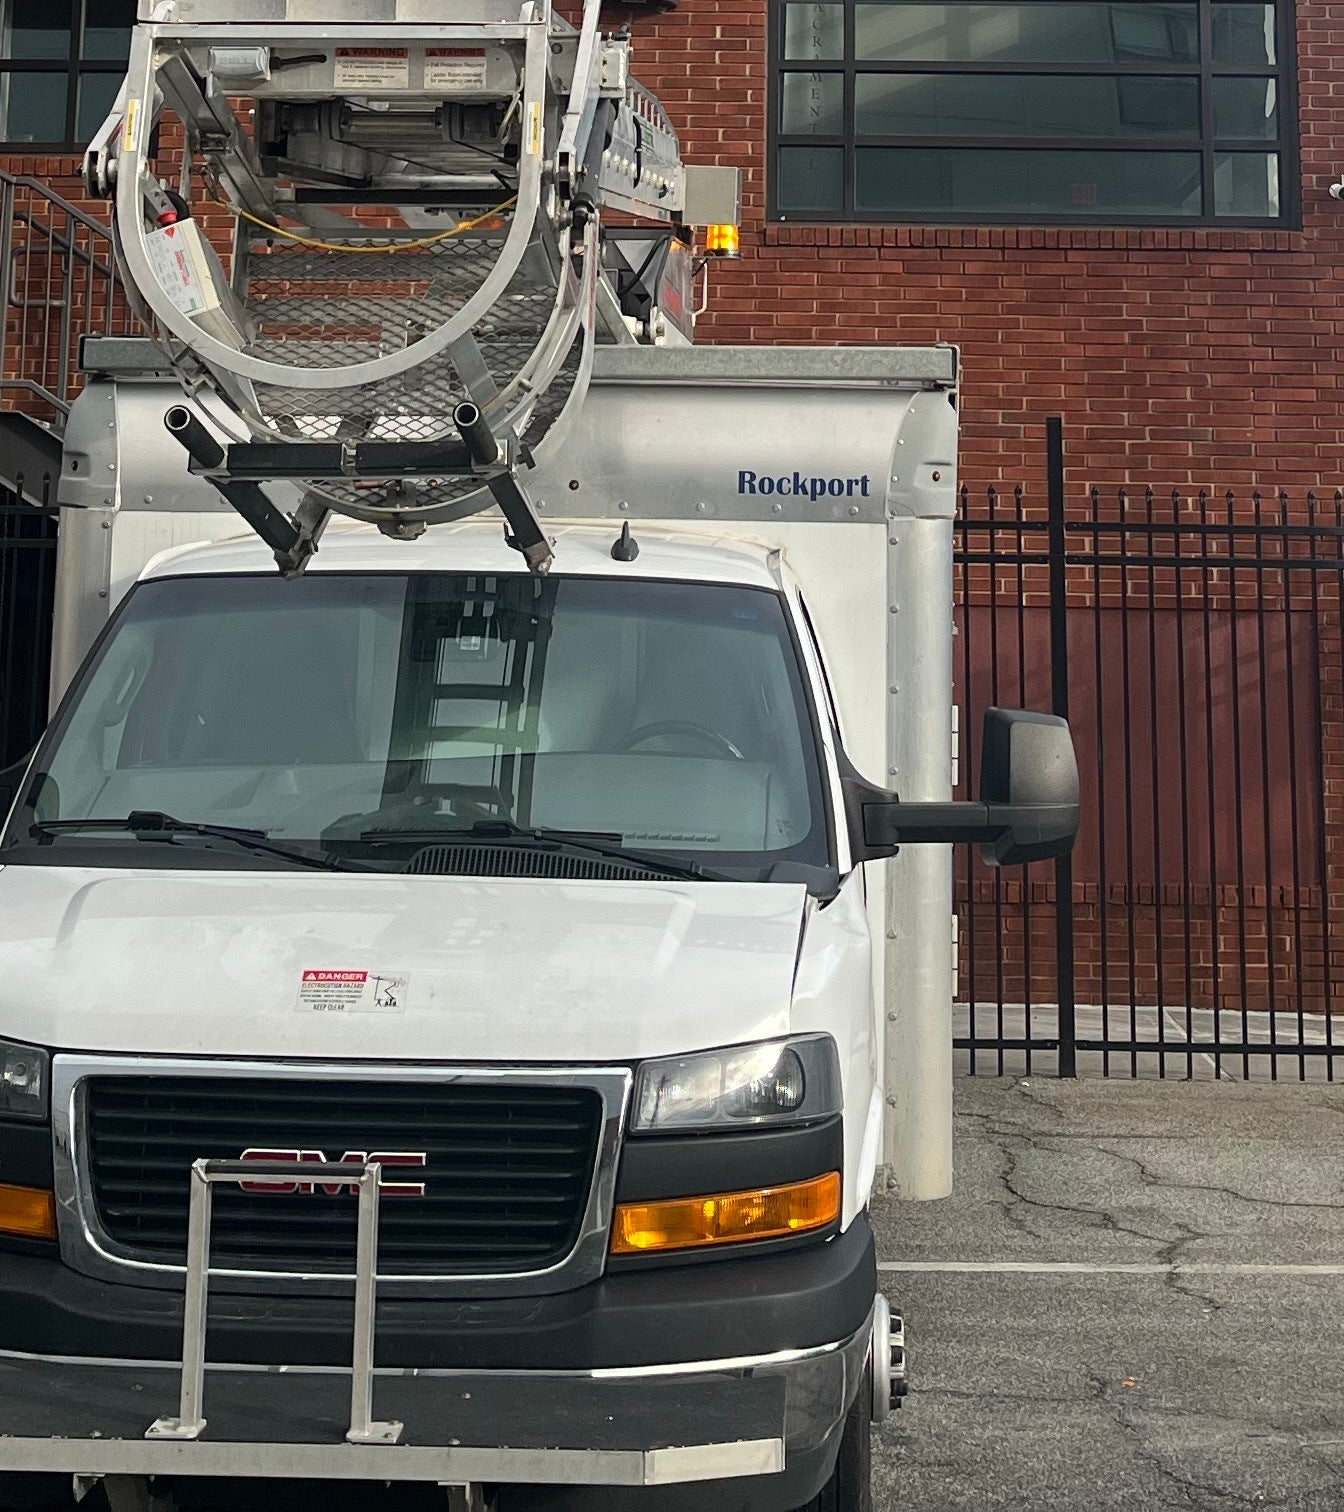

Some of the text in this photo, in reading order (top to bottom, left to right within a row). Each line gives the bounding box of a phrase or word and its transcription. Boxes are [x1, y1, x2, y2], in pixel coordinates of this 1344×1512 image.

[738, 470, 871, 501] Rockport
[317, 972, 364, 981] DANGER
[327, 1003, 345, 1011] CLEAR
